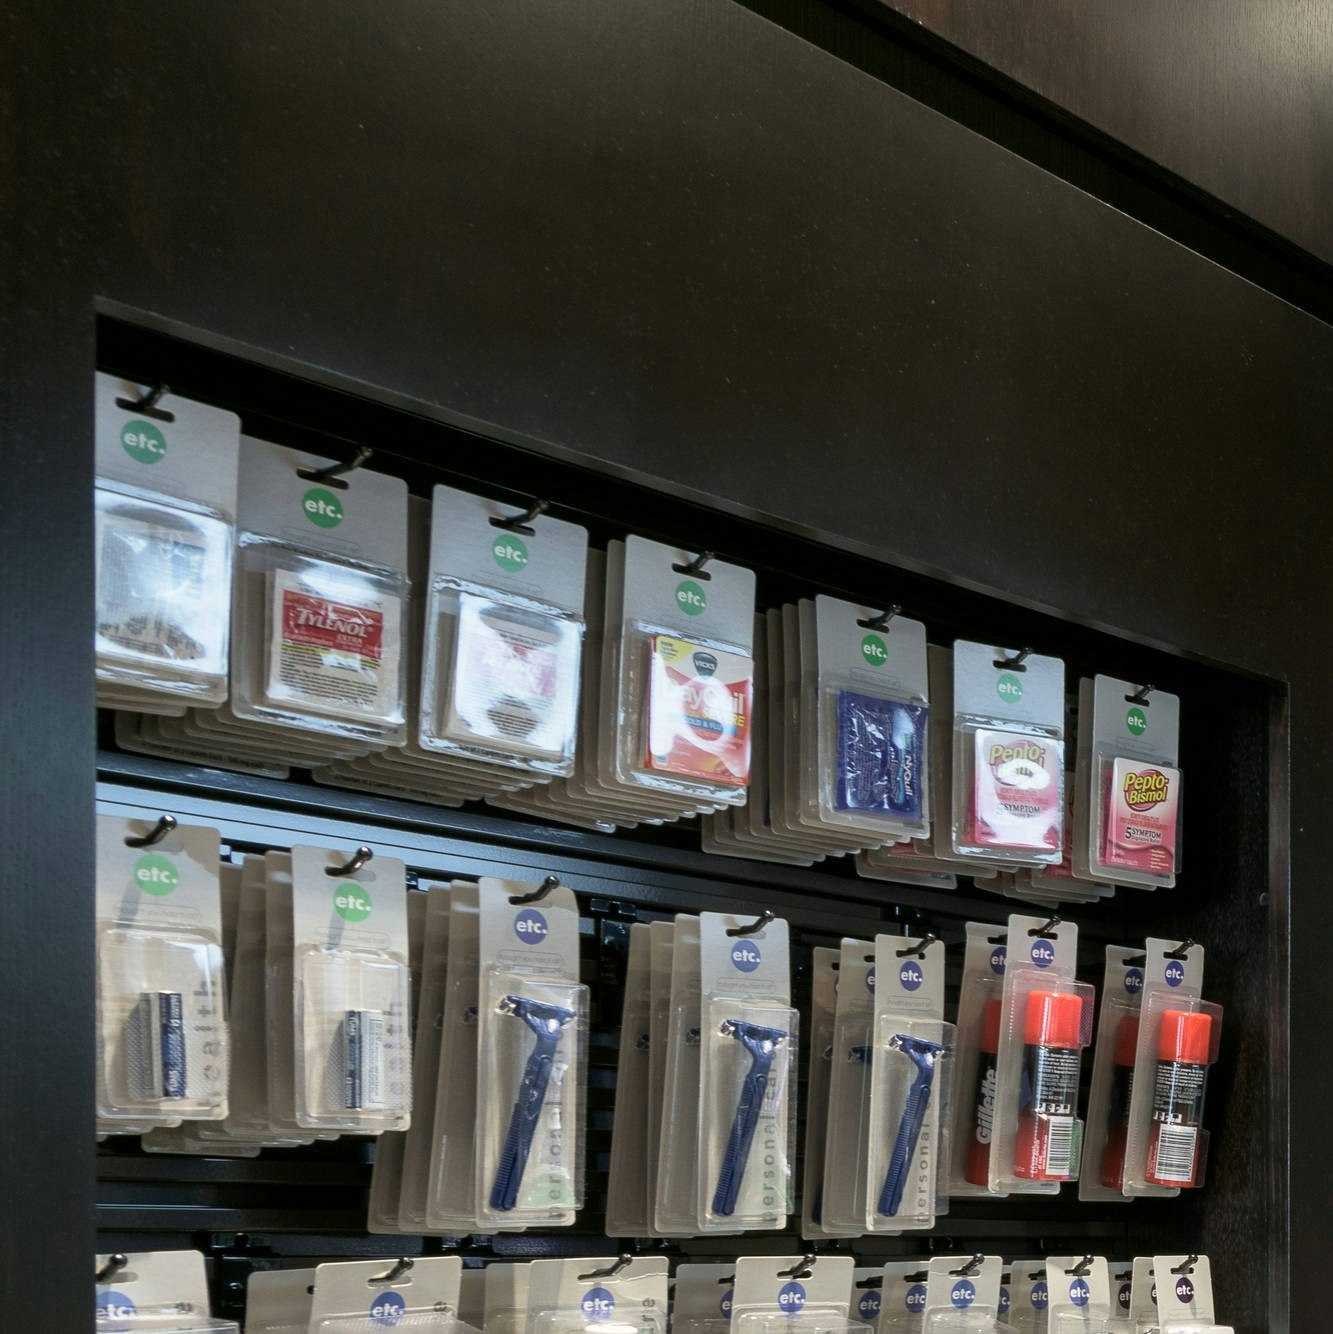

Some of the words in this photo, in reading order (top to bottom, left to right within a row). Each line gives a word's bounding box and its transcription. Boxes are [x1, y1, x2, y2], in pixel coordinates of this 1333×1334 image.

[124, 430, 166, 456] etc.
[303, 497, 343, 521] etc.
[493, 542, 528, 565] etc.
[677, 588, 706, 609] etc.
[297, 607, 368, 638] TYLENOL
[862, 643, 888, 661] etc.
[1128, 788, 1167, 804] Bismol
[136, 866, 178, 885] etc.
[335, 894, 373, 912] etc.
[515, 919, 548, 935] etc.
[732, 948, 761, 965] etc.
[1032, 946, 1055, 961] etc.
[899, 970, 923, 985] etc.
[976, 1068, 998, 1145] Gillette
